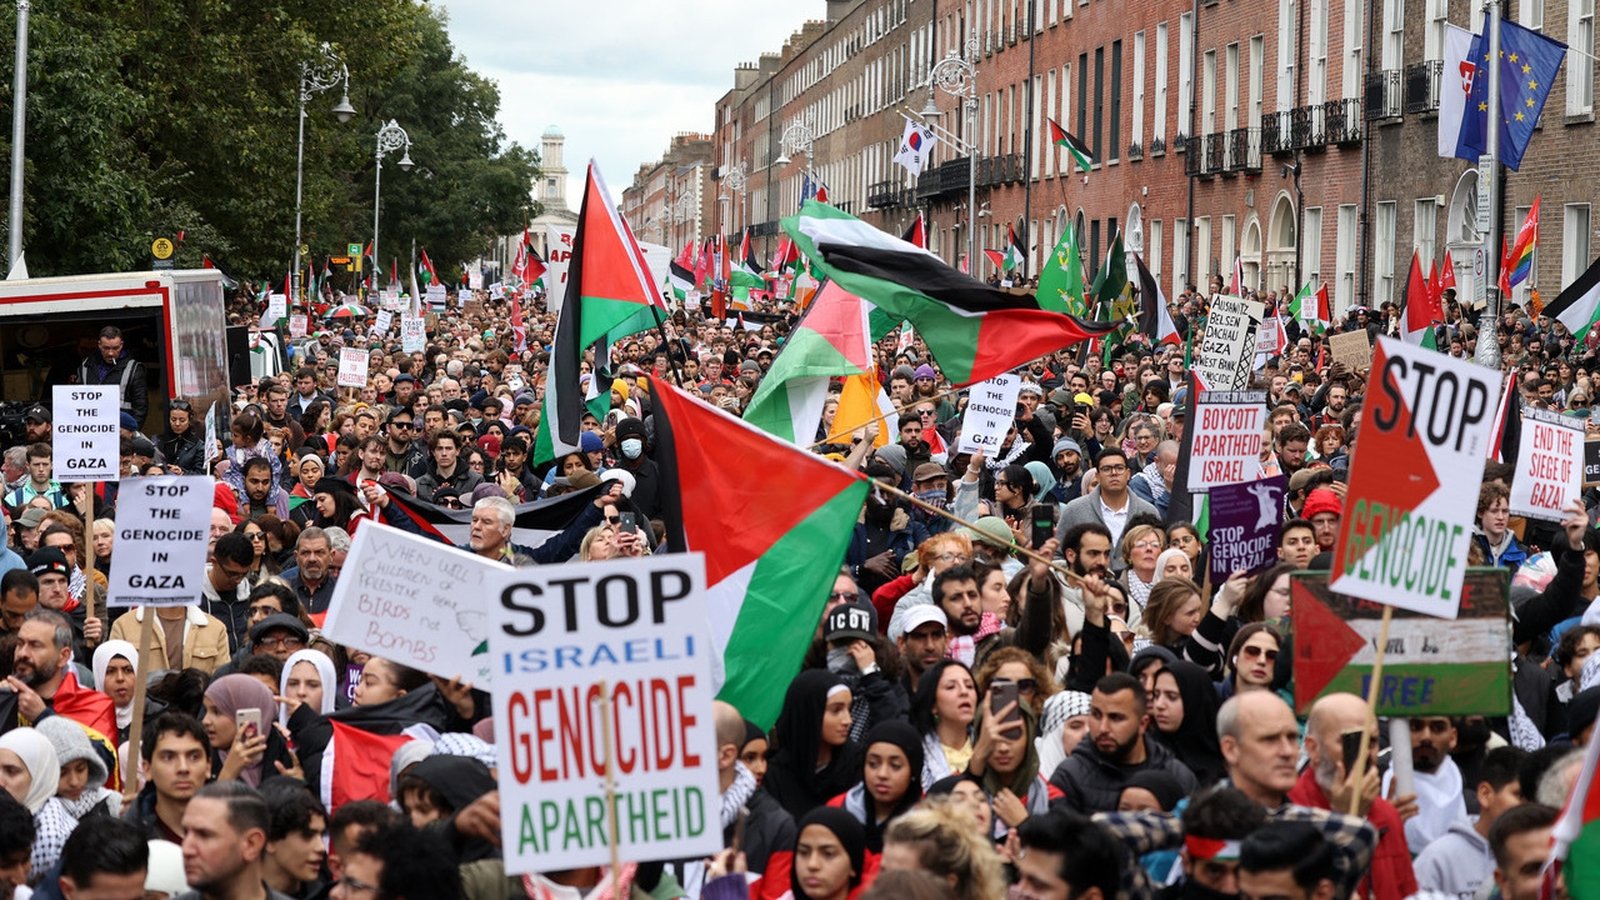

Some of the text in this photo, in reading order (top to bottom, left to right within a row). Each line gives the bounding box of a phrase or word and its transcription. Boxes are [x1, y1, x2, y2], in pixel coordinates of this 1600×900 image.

[1209, 312, 1241, 328] BELSEN
[1206, 326, 1239, 341] DACHAU
[1203, 341, 1230, 355] GAZA
[344, 351, 365, 362] FREEDOM
[1218, 358, 1237, 372] BANK
[985, 378, 1009, 386] STOP
[1200, 370, 1231, 384] ENOCIDE
[72, 392, 102, 400] STOP
[987, 392, 1003, 400] THE
[1374, 354, 1488, 452] STOP
[76, 408, 98, 417] THE
[970, 403, 1012, 417] GENOCIDE
[1202, 408, 1259, 430] BOYCOTT
[58, 425, 115, 433] GENOCIDE
[81, 441, 93, 449] IN
[972, 434, 998, 445] GAZA
[1192, 434, 1260, 456] APARTHEID
[1533, 424, 1554, 451] END
[1556, 430, 1574, 456] THE
[67, 458, 107, 469] GAZA
[1201, 460, 1244, 482] ISRAEL
[1529, 453, 1573, 483] SIEGE OF
[1585, 464, 1600, 475] GE
[145, 484, 189, 497] STOP
[1530, 482, 1566, 511] GAZA!
[149, 508, 181, 519] THE
[121, 529, 204, 541] GENOCIDE
[1212, 525, 1244, 544] STOP
[370, 537, 432, 567] WHEN
[1213, 533, 1272, 558] GENOCIDE
[1344, 498, 1463, 600] GENOCIDE
[152, 552, 168, 562] IN
[1213, 558, 1226, 573] IN
[1231, 551, 1265, 573] GAZA!
[362, 557, 432, 586] CHILDREN
[128, 574, 185, 589] GAZA
[358, 594, 410, 620] BIRDS
[500, 569, 692, 637] STOP
[830, 612, 869, 632] ICON
[1422, 635, 1440, 654] be
[503, 635, 695, 674] ISRAELI
[508, 675, 702, 785] GENOCIDE
[518, 786, 706, 856] APARTHEID
